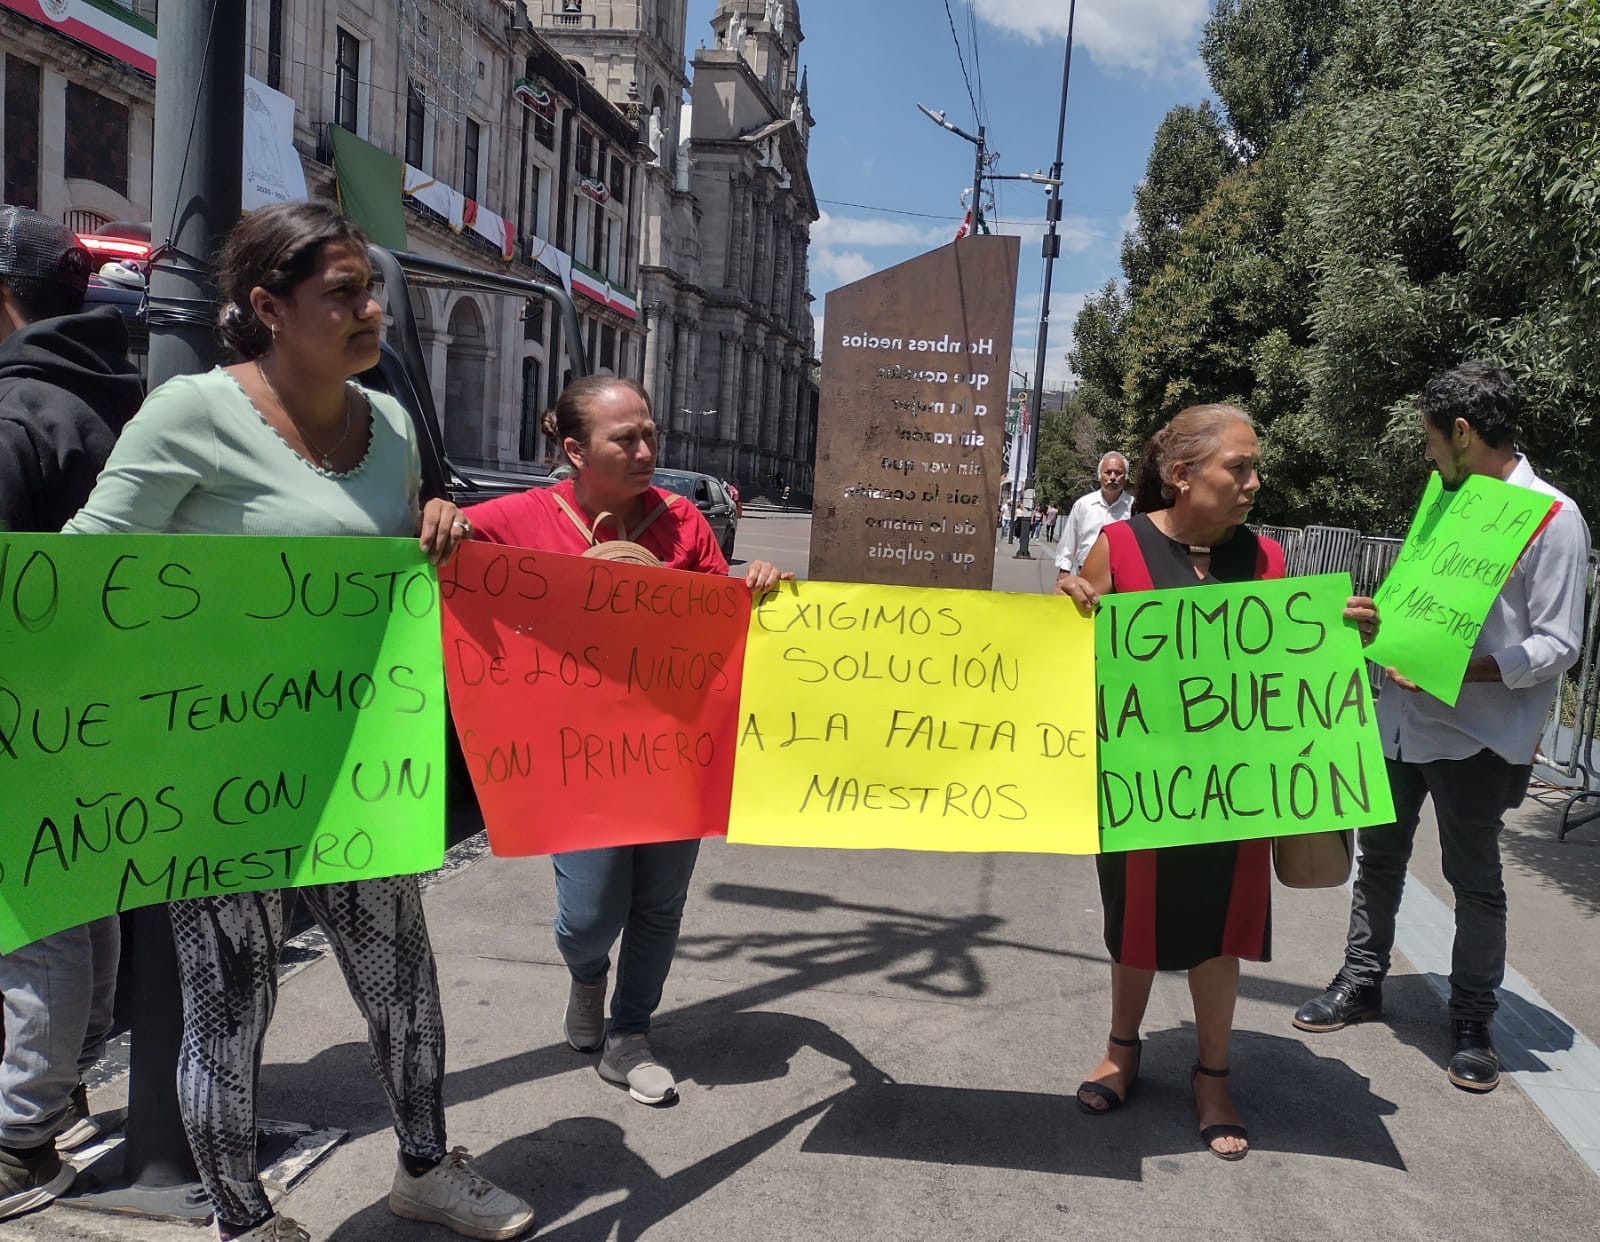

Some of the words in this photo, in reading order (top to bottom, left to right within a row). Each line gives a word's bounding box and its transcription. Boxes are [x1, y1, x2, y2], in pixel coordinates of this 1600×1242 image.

[1450, 490, 1483, 519] DE
[1481, 501, 1532, 538] LA
[102, 554, 200, 629] ES
[246, 552, 435, 619] JUSTO
[440, 542, 549, 600] LOS
[582, 565, 737, 618] DERECHOS
[1432, 541, 1510, 587] QUIEREN
[757, 589, 963, 637] EXIGIMOS
[1095, 591, 1326, 661] IGIMOS
[1394, 585, 1482, 650] MAESTROS
[139, 665, 427, 732] TENGAMOS
[455, 638, 510, 687] DE
[524, 646, 602, 688] LOS
[627, 646, 729, 694] NIÑOS
[783, 642, 1019, 693] SOLUCIÓN
[1179, 667, 1369, 733] BUENA
[463, 728, 532, 786] SON
[559, 726, 715, 787] PRIMERO
[740, 712, 765, 751] A
[779, 711, 849, 748] LA
[885, 709, 1017, 752] FALTA
[1036, 722, 1086, 758] DE
[799, 774, 1028, 820] MAESTROS
[1099, 739, 1372, 830] DUCACIÓN
[24, 786, 184, 886] AÑOS
[213, 772, 307, 825] CON
[352, 758, 431, 801] UN
[116, 828, 374, 912] MAESTRO
